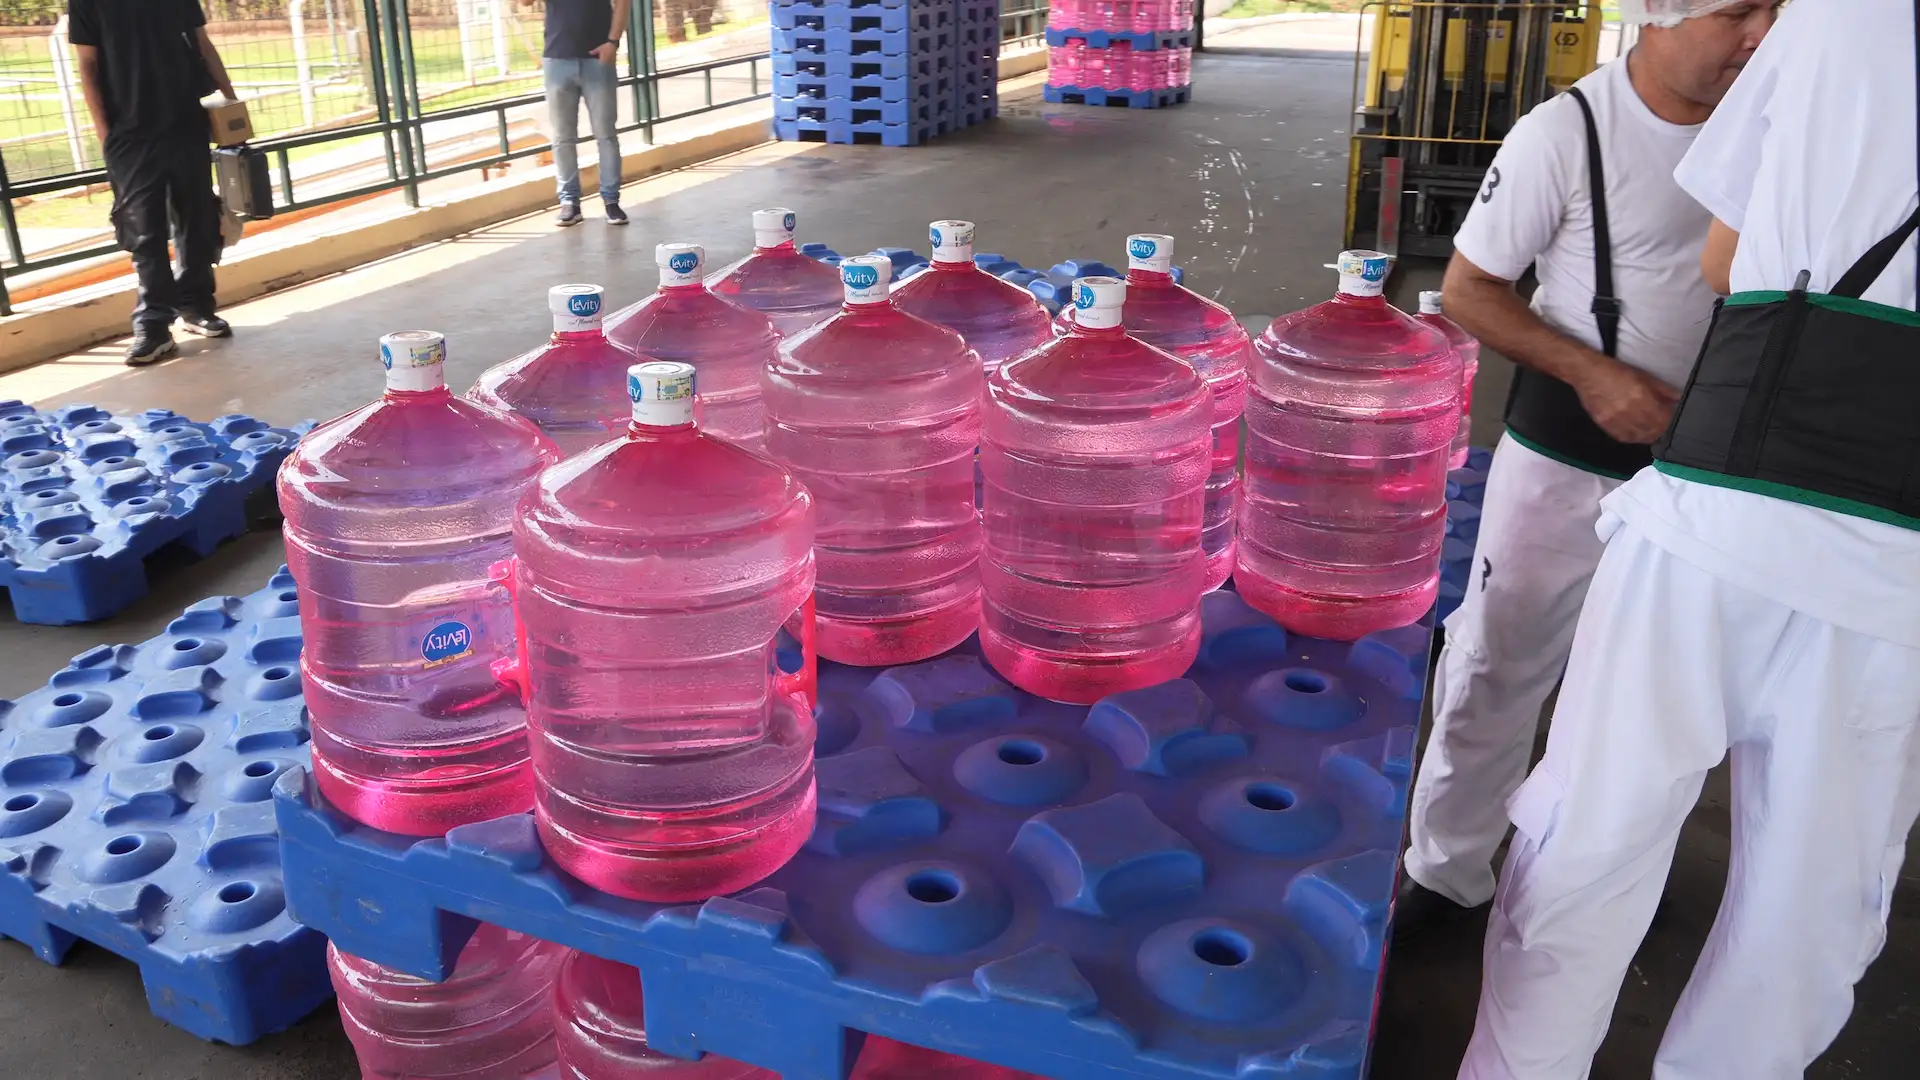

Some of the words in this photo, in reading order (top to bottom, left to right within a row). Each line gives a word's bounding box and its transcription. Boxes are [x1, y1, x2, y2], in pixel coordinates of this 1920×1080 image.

[1481, 166, 1501, 204] 3
[1130, 240, 1155, 256] Levity
[671, 258, 697, 269] Levity
[571, 298, 600, 313] Levity
[425, 628, 467, 653] Levity
